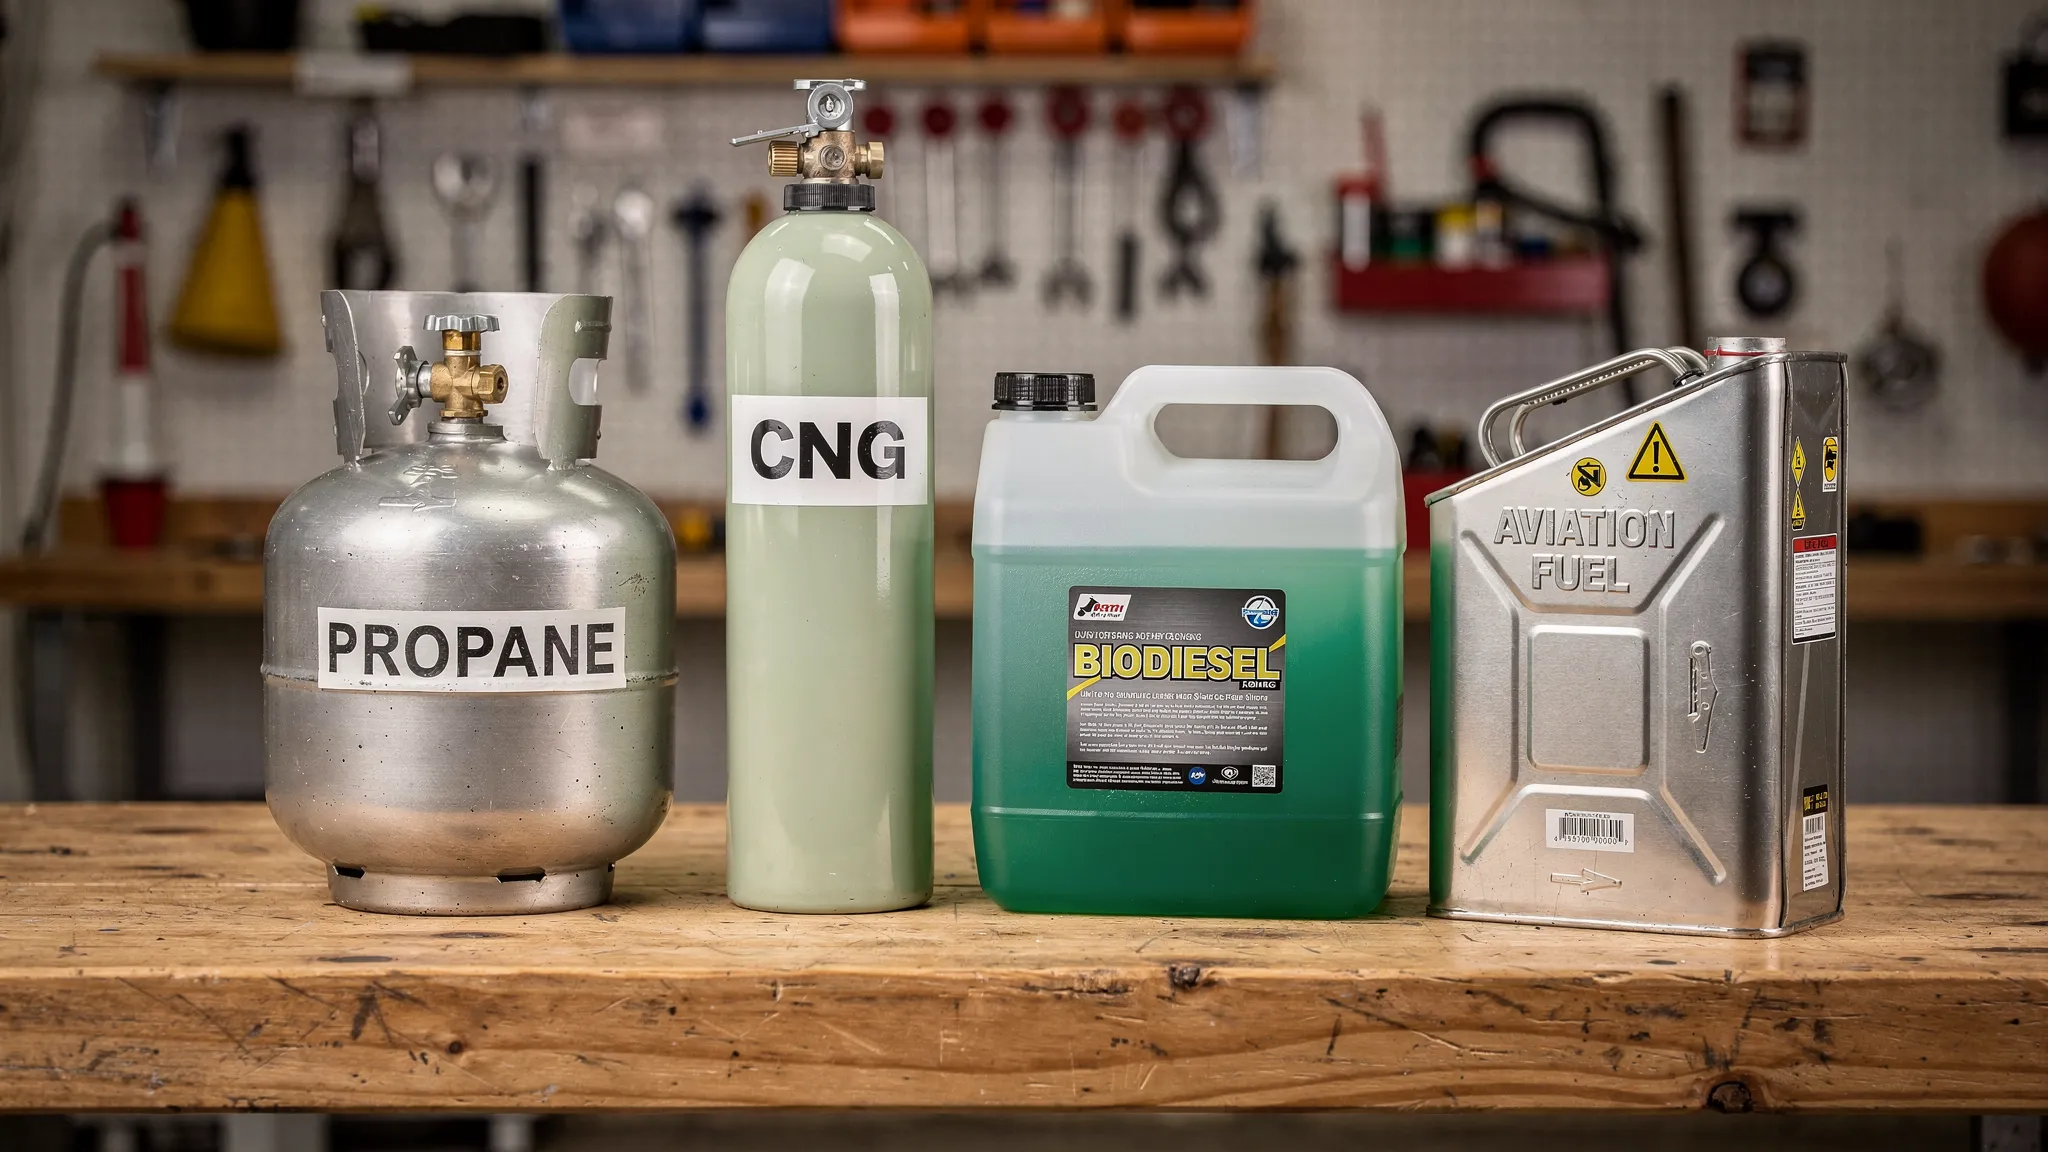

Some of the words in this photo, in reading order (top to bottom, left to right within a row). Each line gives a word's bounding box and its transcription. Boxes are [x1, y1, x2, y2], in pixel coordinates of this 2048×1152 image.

[751, 419, 906, 480] CNG
[1494, 506, 1675, 549] AVIATION
[1532, 553, 1631, 594] FUEL
[328, 622, 615, 678] PROPANE
[1074, 643, 1281, 682] BIODIESEL
